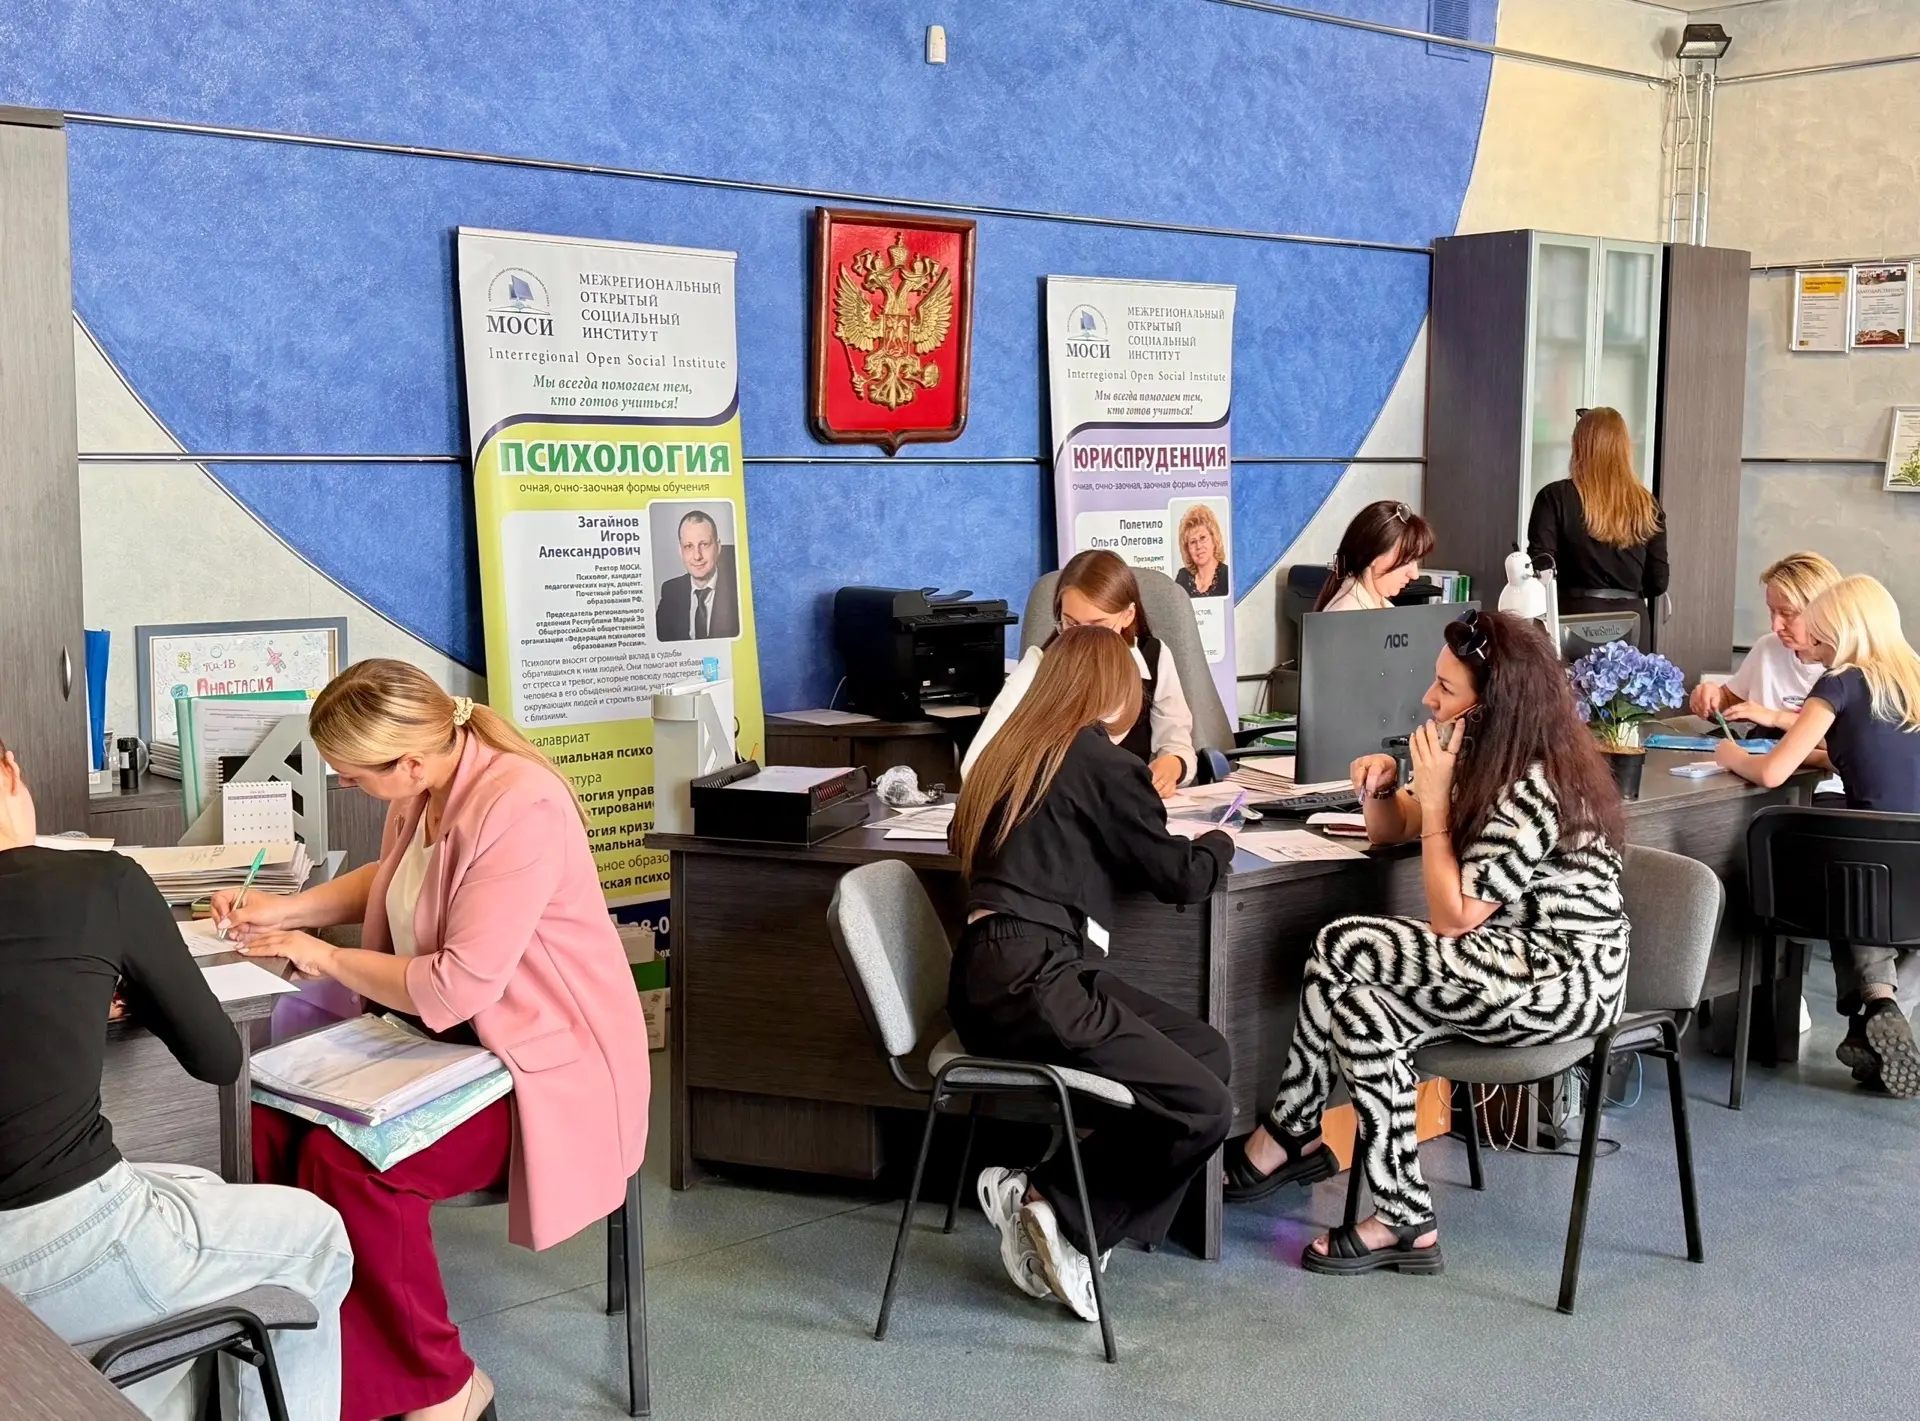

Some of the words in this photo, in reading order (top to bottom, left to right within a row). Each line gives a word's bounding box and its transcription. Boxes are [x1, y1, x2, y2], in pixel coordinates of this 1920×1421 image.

[579, 273, 722, 294] МЕЖРЕГИОНАЛЬНЫЙ
[580, 291, 658, 307] ОТКРЫТЫЙ
[581, 309, 680, 326] СОЦИАЛЬНЫЙ
[1128, 306, 1225, 320] МЕЖРЕГИОНАЛЬНЫЙ
[486, 315, 554, 336] МОСИ
[1128, 321, 1182, 332] ОТКРЫТЫЙ
[582, 327, 658, 342] ИНСТИТУТ
[1128, 335, 1196, 347] СОЦИАЛЬНЫЙ
[489, 347, 579, 364] Interregional
[586, 352, 621, 367] Open
[627, 354, 666, 367] Social
[673, 355, 726, 369] Institute
[1066, 343, 1111, 359] МОСИ
[1128, 350, 1180, 361] ИНСТИТУТ
[1067, 369, 1126, 382] Interregional
[1131, 371, 1154, 383] Open
[1158, 370, 1185, 381] Social
[1190, 371, 1226, 382] Institute
[533, 374, 555, 388] Мы
[558, 376, 598, 391] всегда
[601, 380, 660, 393] помогаем
[663, 382, 693, 395] тем,
[550, 395, 576, 407] кто
[579, 397, 618, 408] готов
[621, 396, 678, 411] учиться!
[1095, 390, 1111, 401] Мы
[1113, 390, 1138, 402] всегда
[1139, 393, 1180, 402] помогаем
[1182, 394, 1203, 404] тем,
[1107, 406, 1124, 415] кто
[1126, 407, 1150, 416] готов
[1152, 405, 1193, 418] учиться!
[499, 441, 731, 474] ПСИХОЛОГИЯ
[1073, 446, 1227, 472] ЮРИСПРУДЕНЦИЯ
[520, 482, 552, 494] очная,
[554, 482, 624, 493] очно-заочная
[626, 481, 661, 494] формы
[663, 481, 710, 494] обучения
[1072, 482, 1094, 491] очная,
[1095, 481, 1142, 491] очно-заочная,
[1143, 481, 1170, 489] заочная
[1172, 479, 1196, 490] формы
[1198, 479, 1228, 489] обучения
[578, 516, 639, 529] Загайнов
[600, 530, 640, 545] Игорь
[1091, 536, 1119, 548] Ольга
[1121, 535, 1163, 546] Олеговна
[539, 545, 641, 559] Александрович
[595, 565, 618, 573] Ректор
[576, 573, 610, 581] Психолог,
[545, 583, 597, 591] педагогических
[576, 589, 610, 597] Почетный
[612, 589, 643, 597] работник
[587, 597, 631, 606] образования
[546, 610, 593, 619] Председатель
[594, 608, 644, 617] регионального
[572, 618, 612, 626] Республики
[538, 627, 596, 636] Общероссийской
[597, 624, 645, 632] общественной
[608, 632, 646, 640] психологов
[572, 642, 617, 651] образования
[1384, 633, 1409, 649] AOC
[521, 658, 560, 668] Психологи
[562, 656, 587, 665] вносят
[589, 653, 628, 664] огромный
[628, 652, 650, 661] вклад
[657, 649, 682, 660] судьбы
[522, 668, 575, 679] обратившихся
[626, 663, 642, 671] Они
[643, 660, 677, 670] помогают
[197, 676, 273, 696] АНАСТАСИЯ
[533, 680, 560, 689] стресса
[568, 678, 596, 688] тревог,
[597, 675, 629, 684] которые
[630, 673, 662, 682] повсюду
[663, 669, 704, 679] подстерега
[524, 691, 557, 701] человека
[565, 689, 577, 698] его
[579, 685, 621, 695] обыденной
[623, 684, 648, 693] жизни,
[524, 701, 572, 711] окружающих
[573, 698, 598, 707] людей
[606, 696, 635, 705] строить
[530, 712, 568, 722] близкими.
[530, 733, 590, 748] калавриат
[553, 750, 614, 766] циальная
[617, 746, 653, 758] психо
[568, 773, 602, 788] атура
[578, 789, 614, 804] логия
[617, 786, 654, 801] управ
[587, 826, 616, 838] огия
[597, 860, 625, 873] ьное
[628, 853, 669, 868] образо
[635, 871, 670, 886] психо
